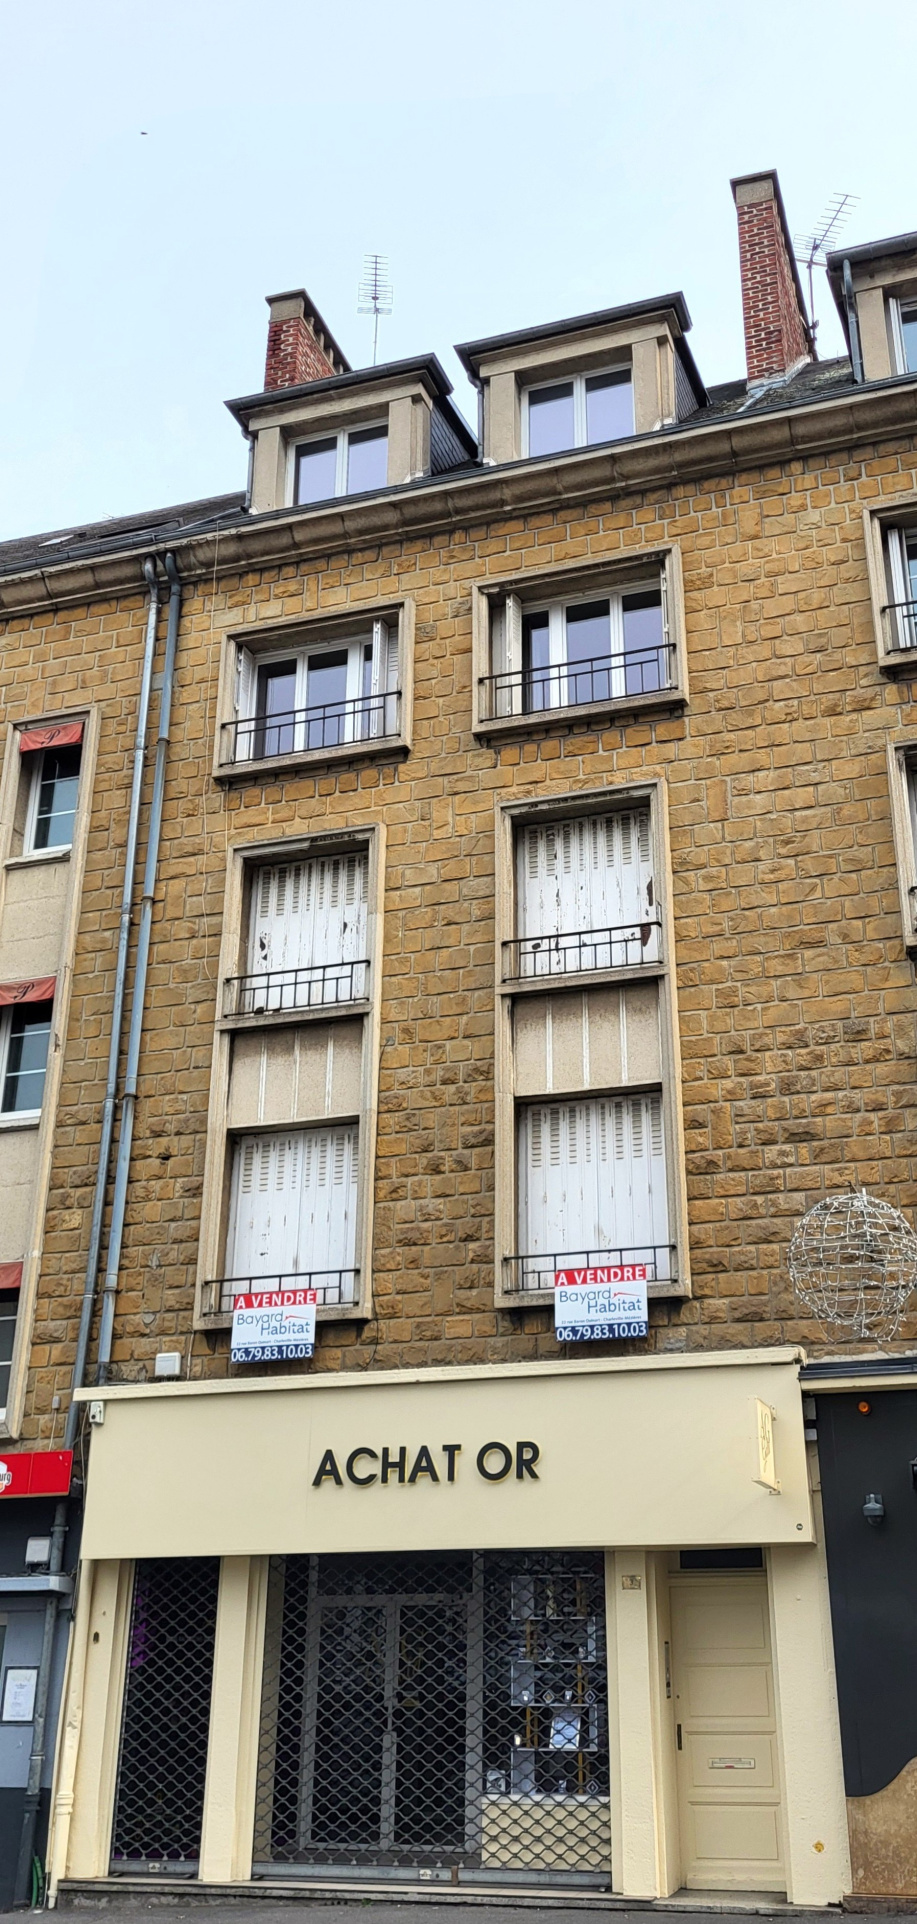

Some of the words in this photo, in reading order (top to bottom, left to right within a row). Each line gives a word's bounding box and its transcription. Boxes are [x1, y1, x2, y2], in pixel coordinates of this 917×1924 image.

[557, 1272, 568, 1286] A
[574, 1266, 644, 1285] VENDRE
[236, 1296, 246, 1309] A
[252, 1291, 314, 1308] VENDRE
[559, 1287, 611, 1305] Bayard
[587, 1298, 642, 1314] Habitat
[236, 1310, 284, 1327] Bayard
[260, 1321, 310, 1336] Habitat
[556, 1322, 647, 1341] 06.79.83.10.03
[231, 1344, 313, 1362] 06.79.83.10.03
[312, 1444, 462, 1487] ACHAT
[476, 1441, 541, 1482] OR
